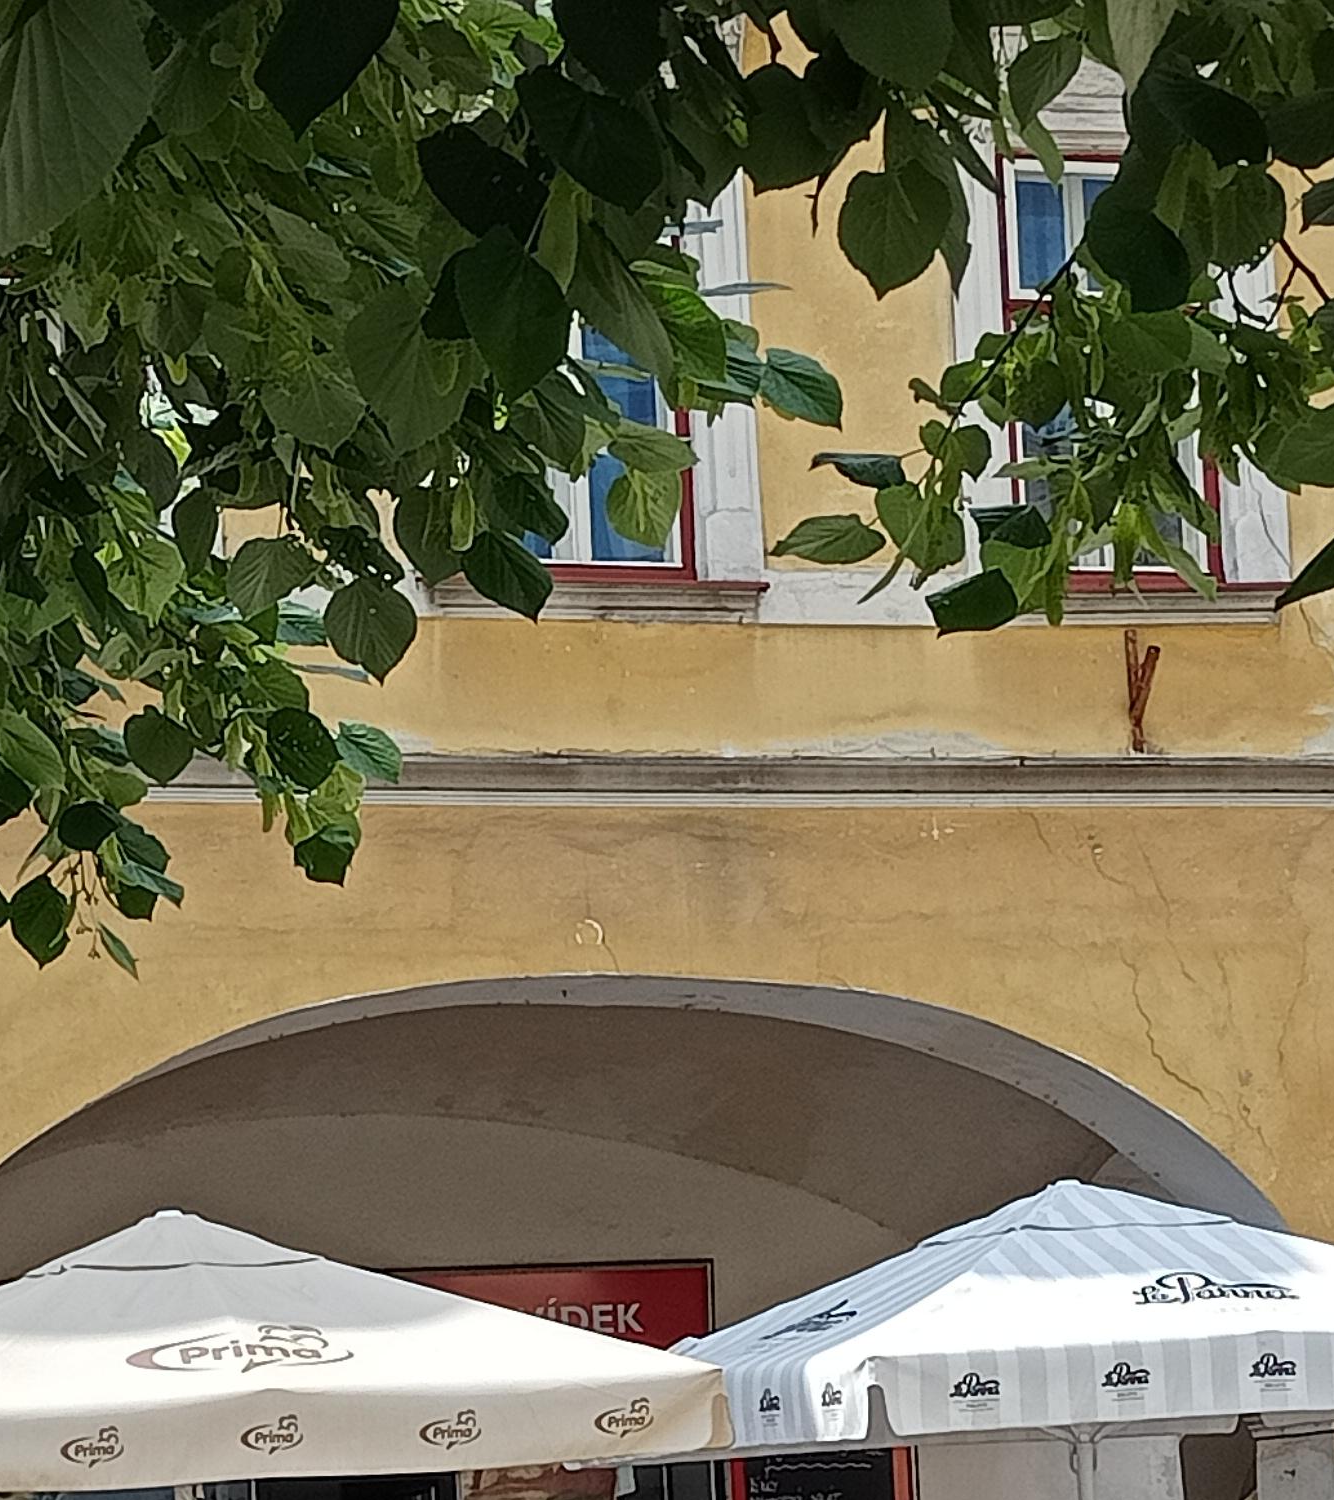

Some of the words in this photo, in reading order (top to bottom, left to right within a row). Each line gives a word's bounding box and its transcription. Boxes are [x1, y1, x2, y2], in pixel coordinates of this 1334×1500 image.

[1156, 1272, 1299, 1304] Panna
[179, 1340, 322, 1365] Prima
[608, 1414, 646, 1428] Prima
[255, 1430, 294, 1444] Prima
[433, 1425, 473, 1440] Prima
[74, 1442, 115, 1457] Prima
